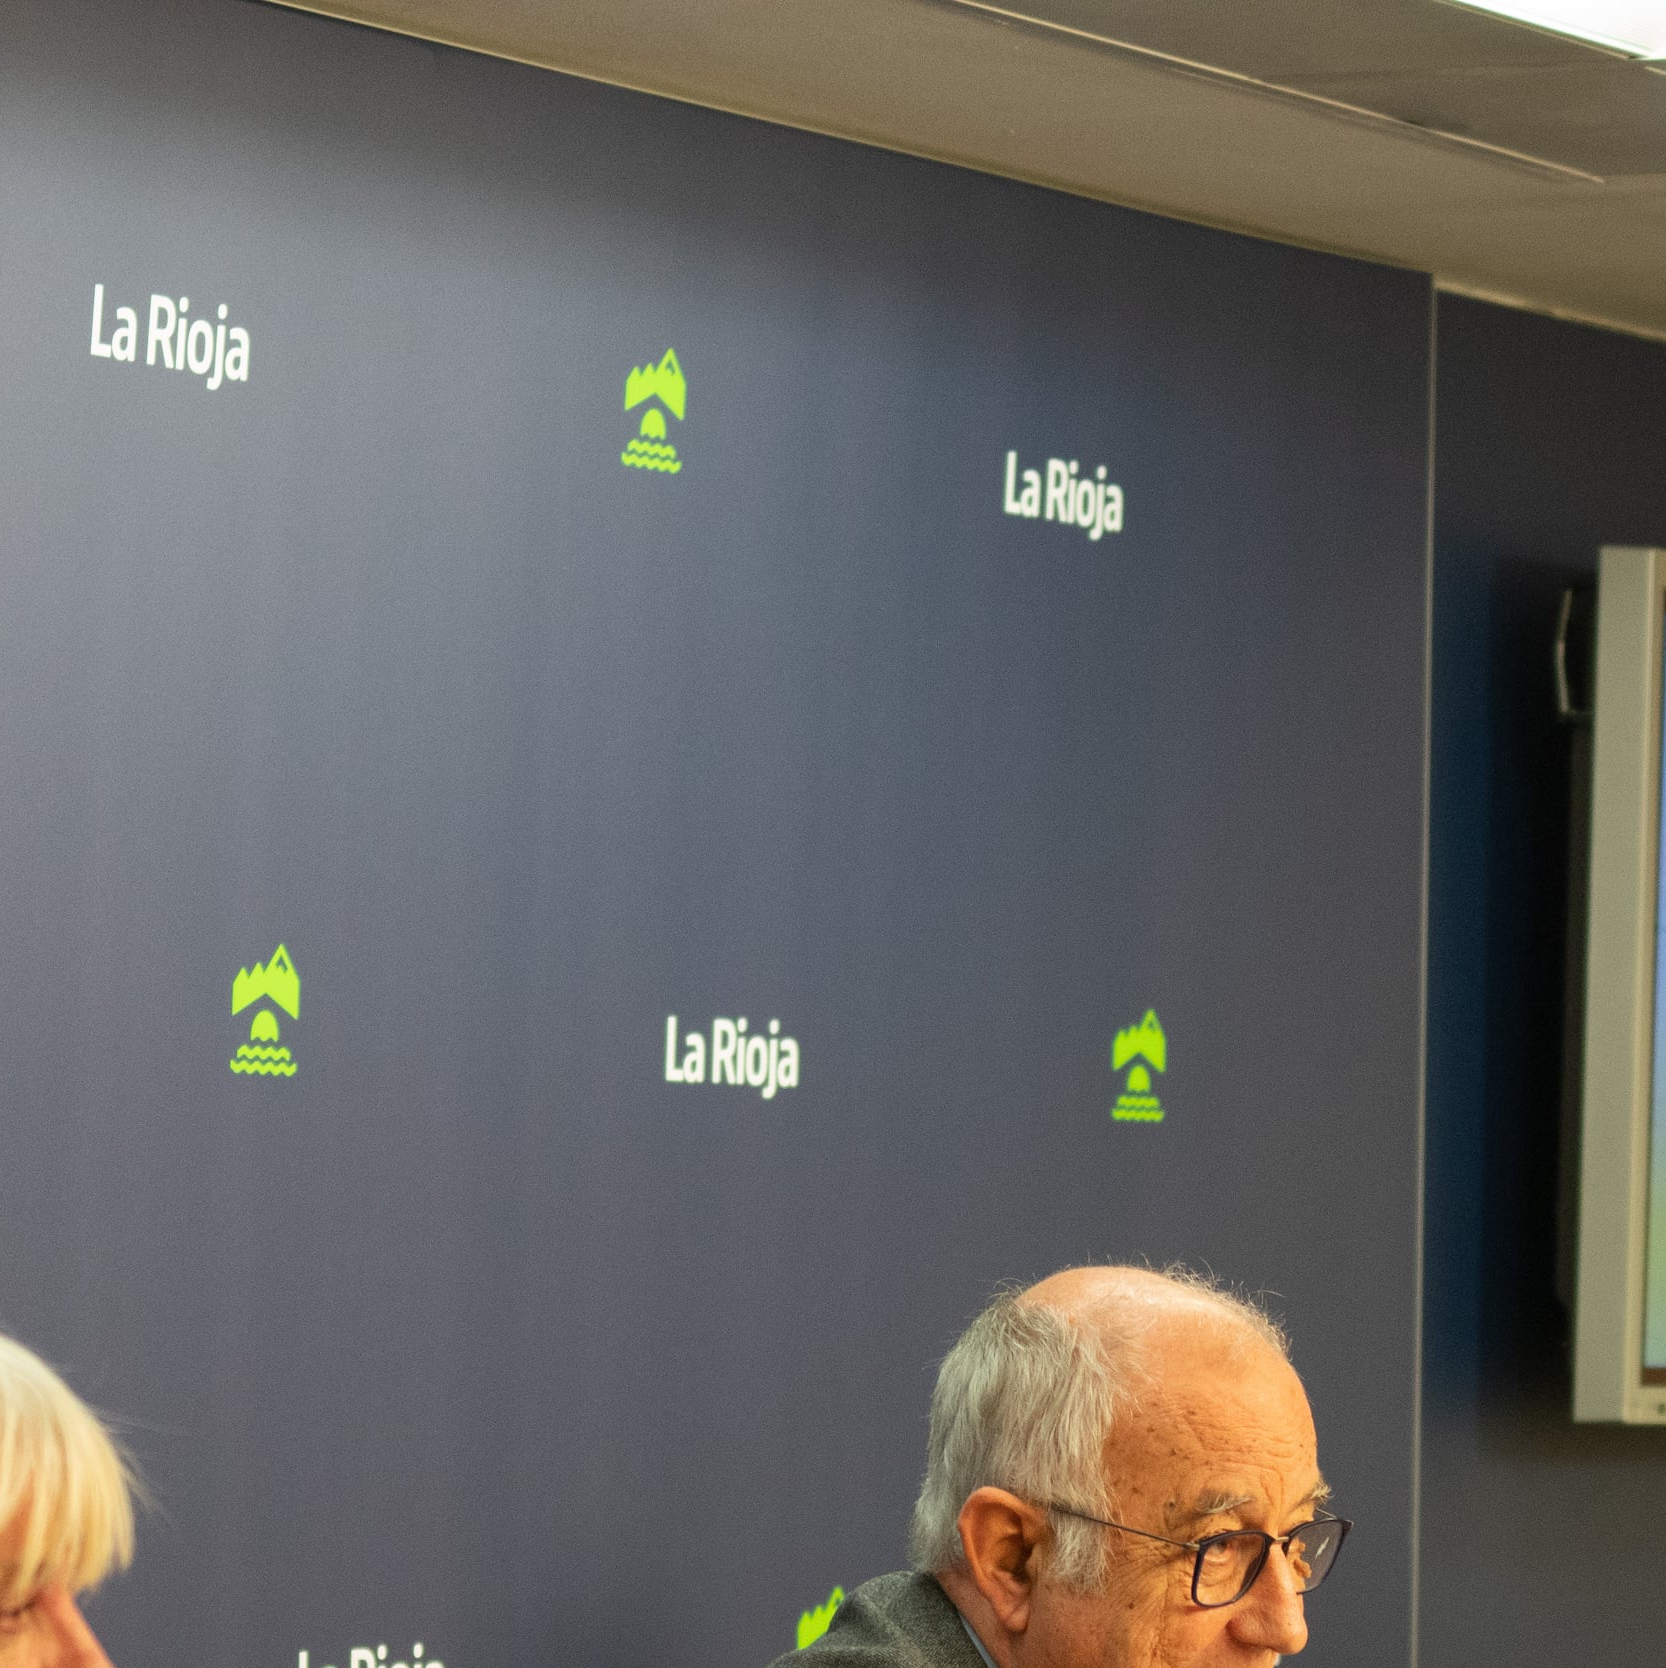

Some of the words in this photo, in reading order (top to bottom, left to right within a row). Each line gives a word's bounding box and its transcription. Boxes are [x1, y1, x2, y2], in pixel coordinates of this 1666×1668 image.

[89, 283, 138, 363] La
[144, 293, 251, 391] Rioja
[1003, 450, 1043, 519] La
[1044, 458, 1124, 541] Rioja
[664, 1015, 706, 1085] La
[710, 1016, 800, 1101] Rioja
